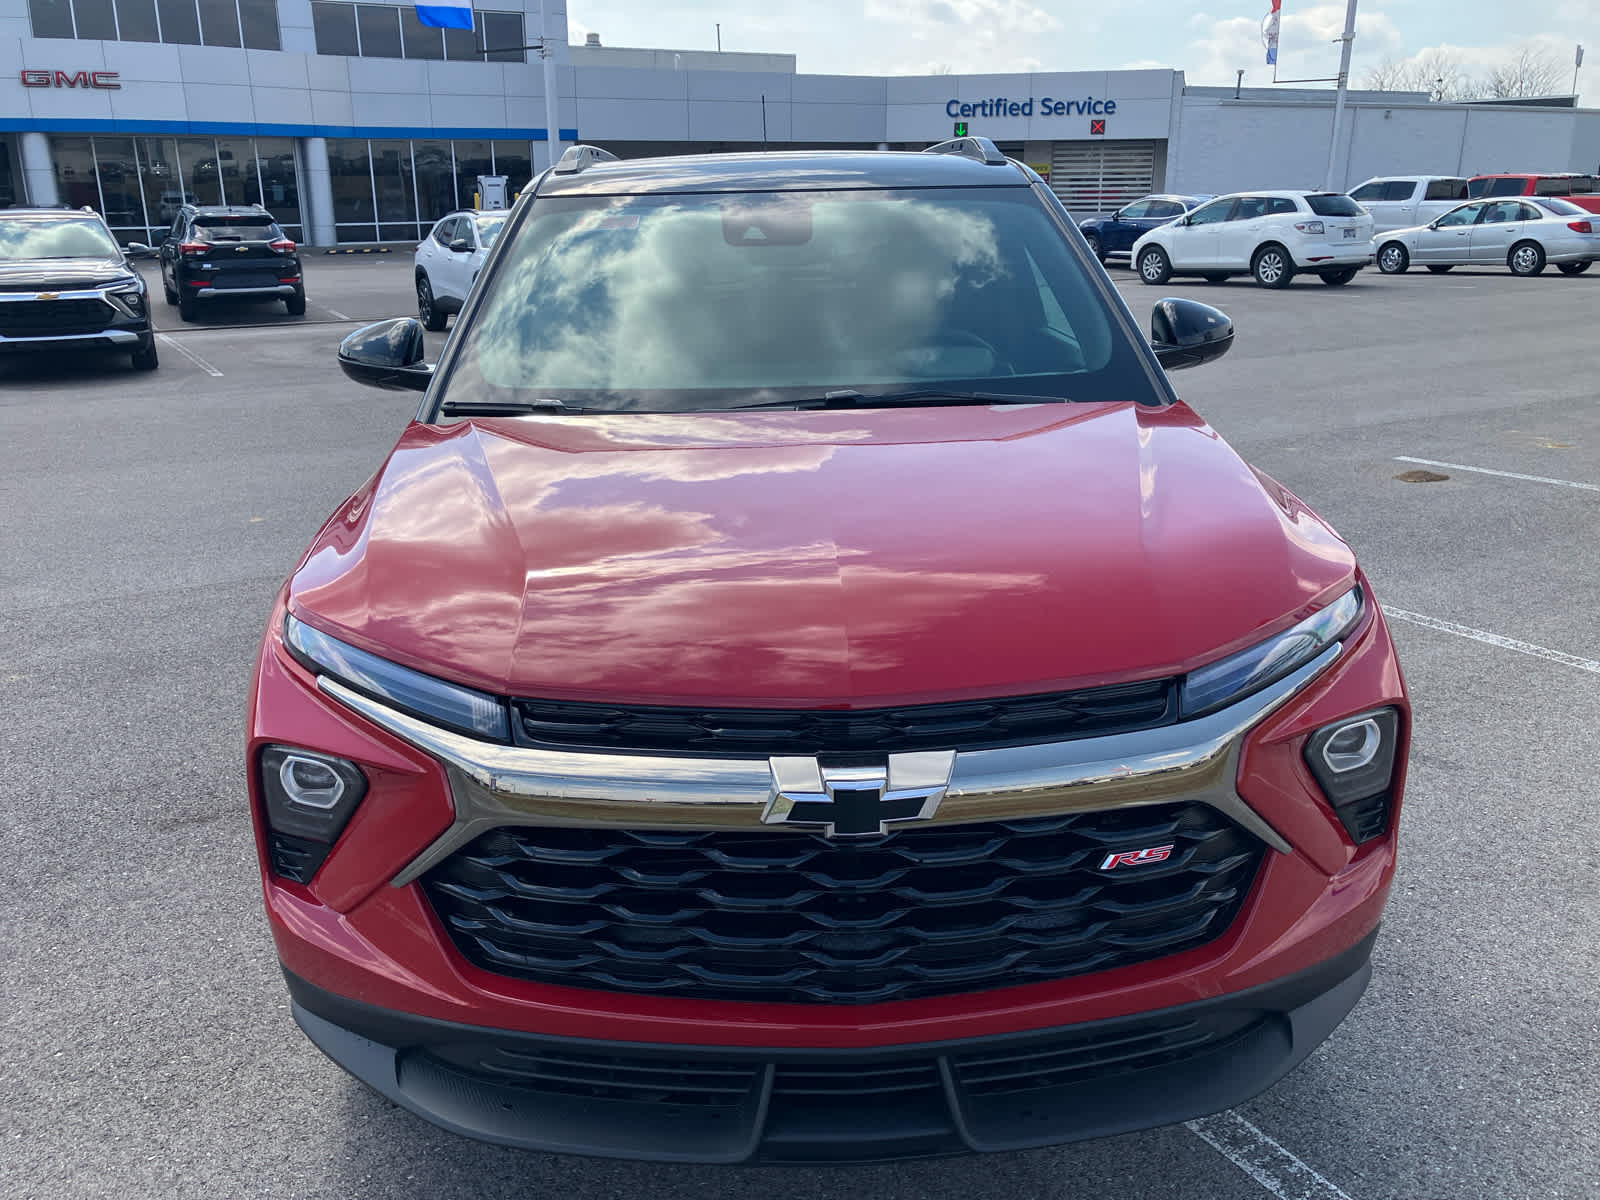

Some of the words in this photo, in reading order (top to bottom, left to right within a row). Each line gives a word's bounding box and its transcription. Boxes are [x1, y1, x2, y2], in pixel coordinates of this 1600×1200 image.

[20, 70, 121, 89] GMC
[946, 98, 1033, 118] Certified
[1040, 97, 1116, 116] Service
[1100, 845, 1174, 869] RS
